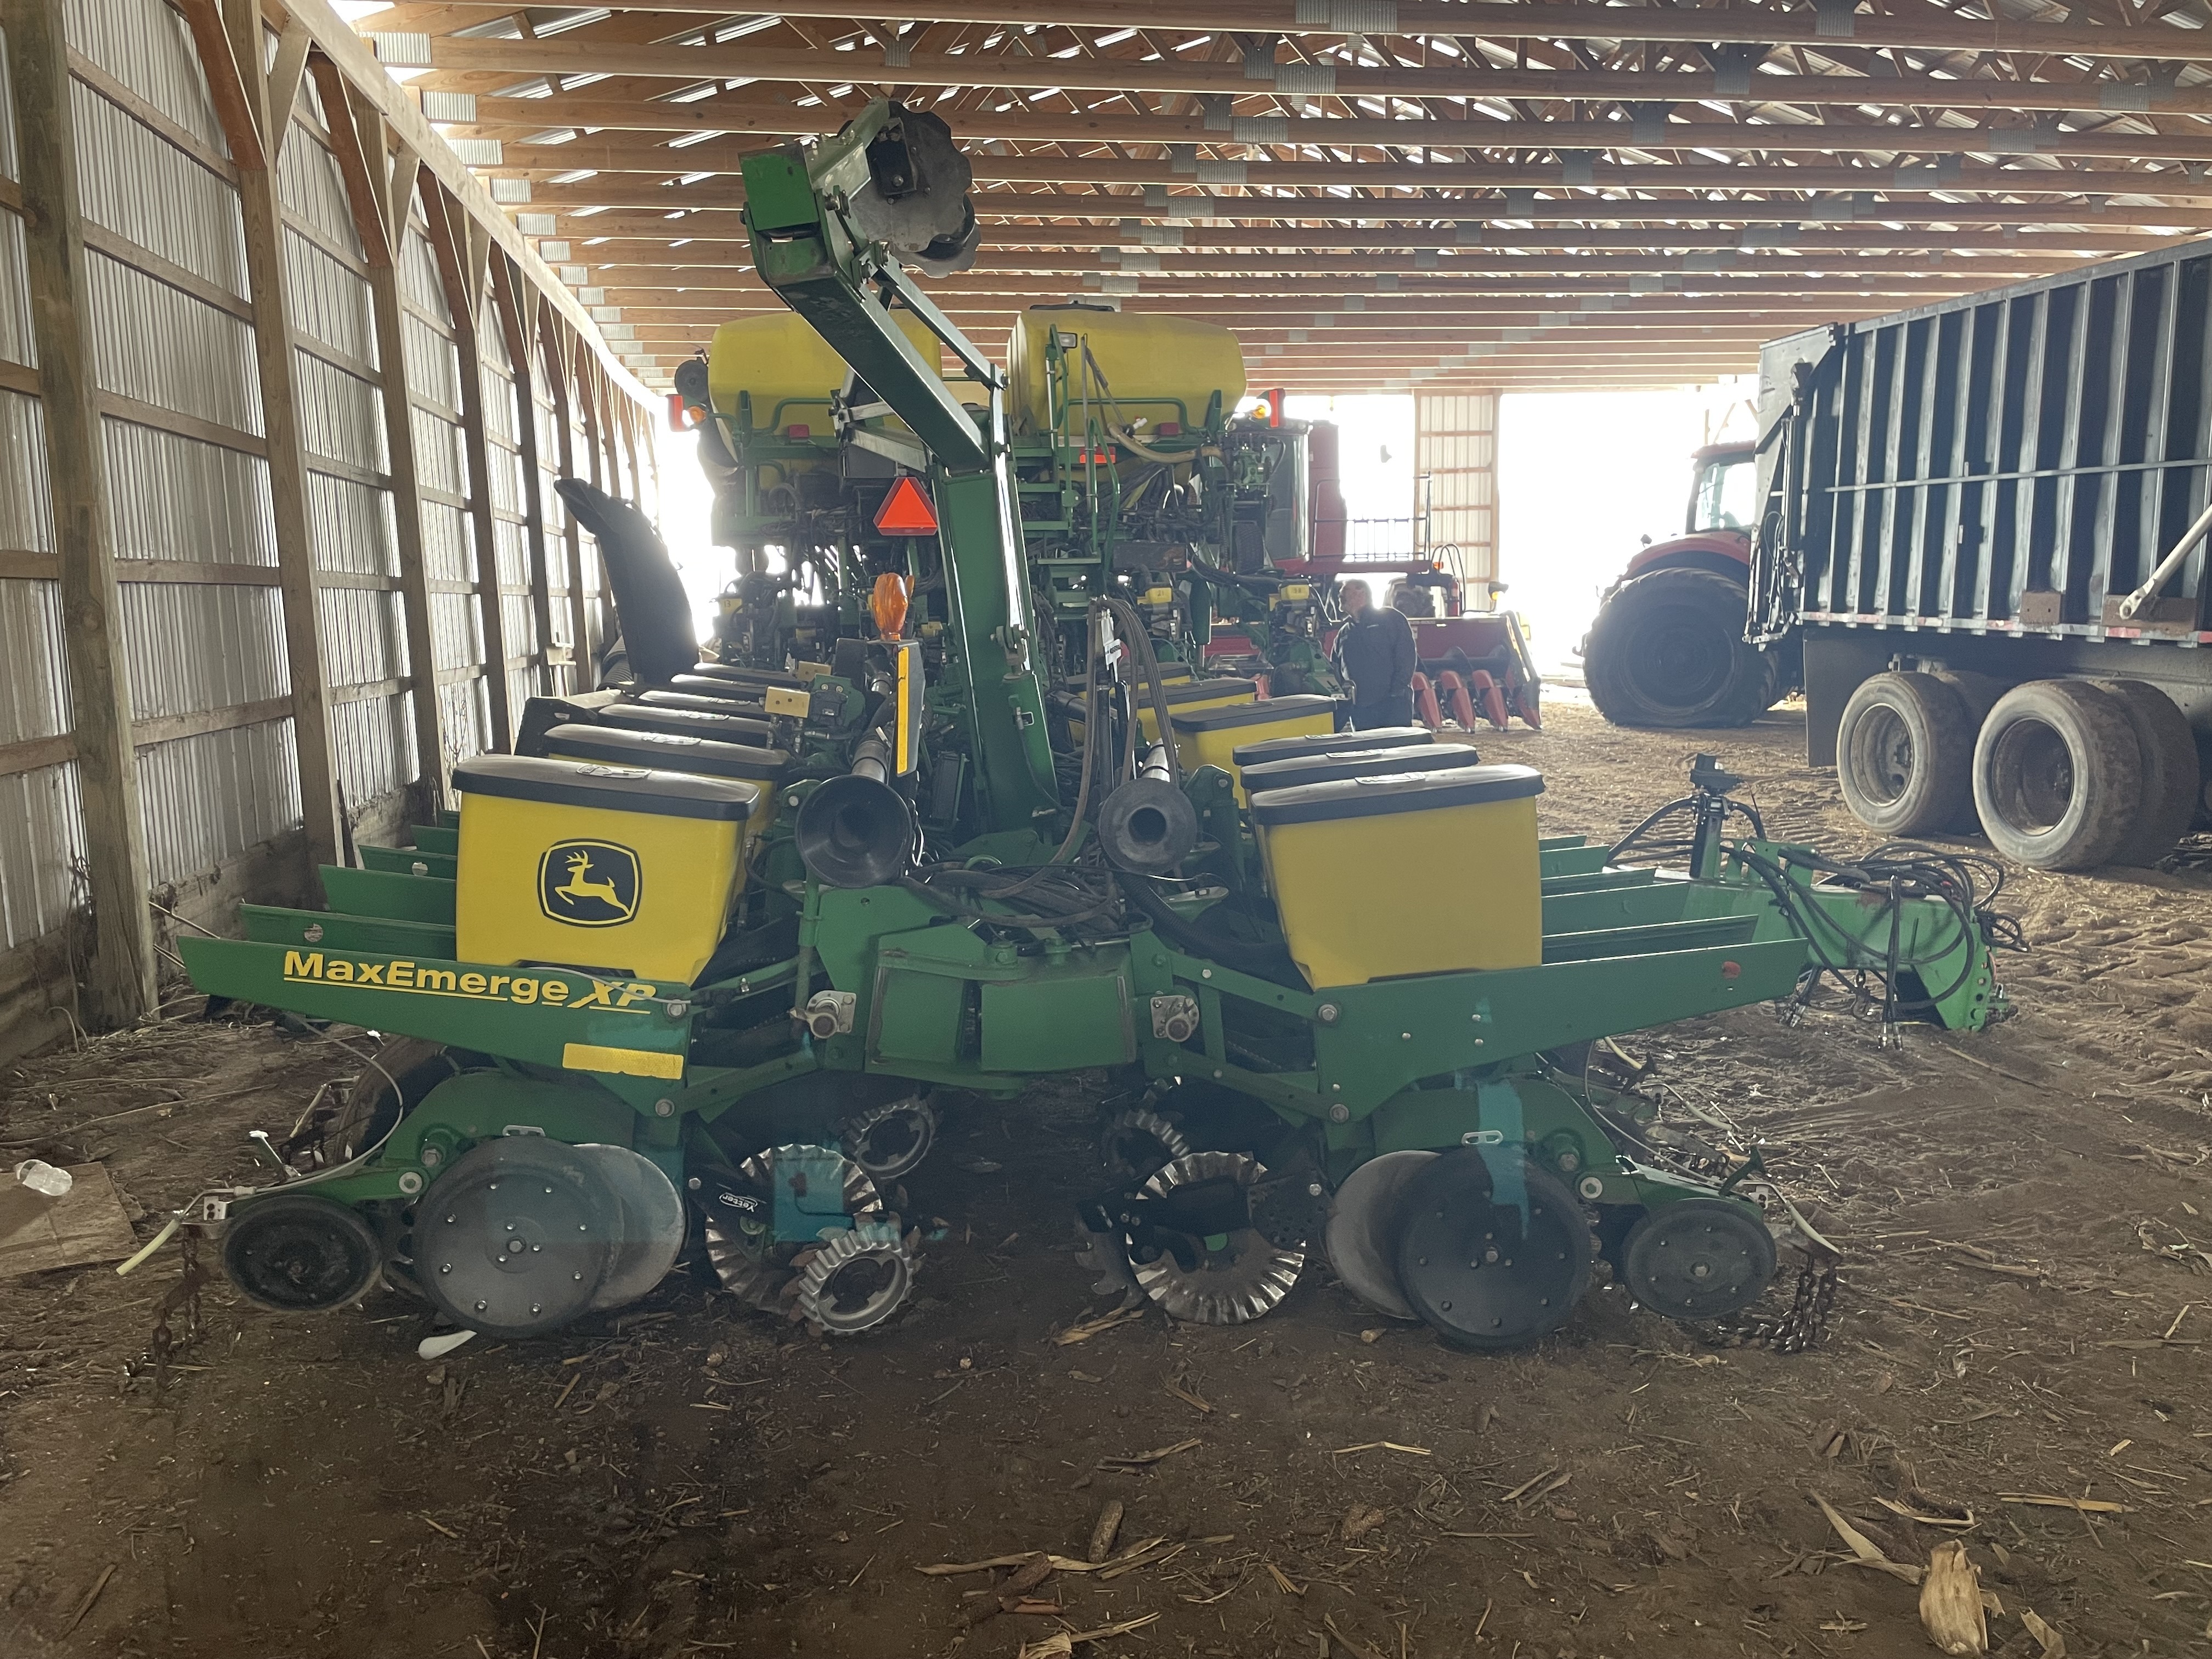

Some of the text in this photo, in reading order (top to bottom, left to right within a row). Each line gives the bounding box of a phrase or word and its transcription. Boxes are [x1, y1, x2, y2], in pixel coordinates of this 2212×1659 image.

[284, 950, 656, 1008] MaxEmerge XP
[722, 1195, 754, 1212] Yetter
